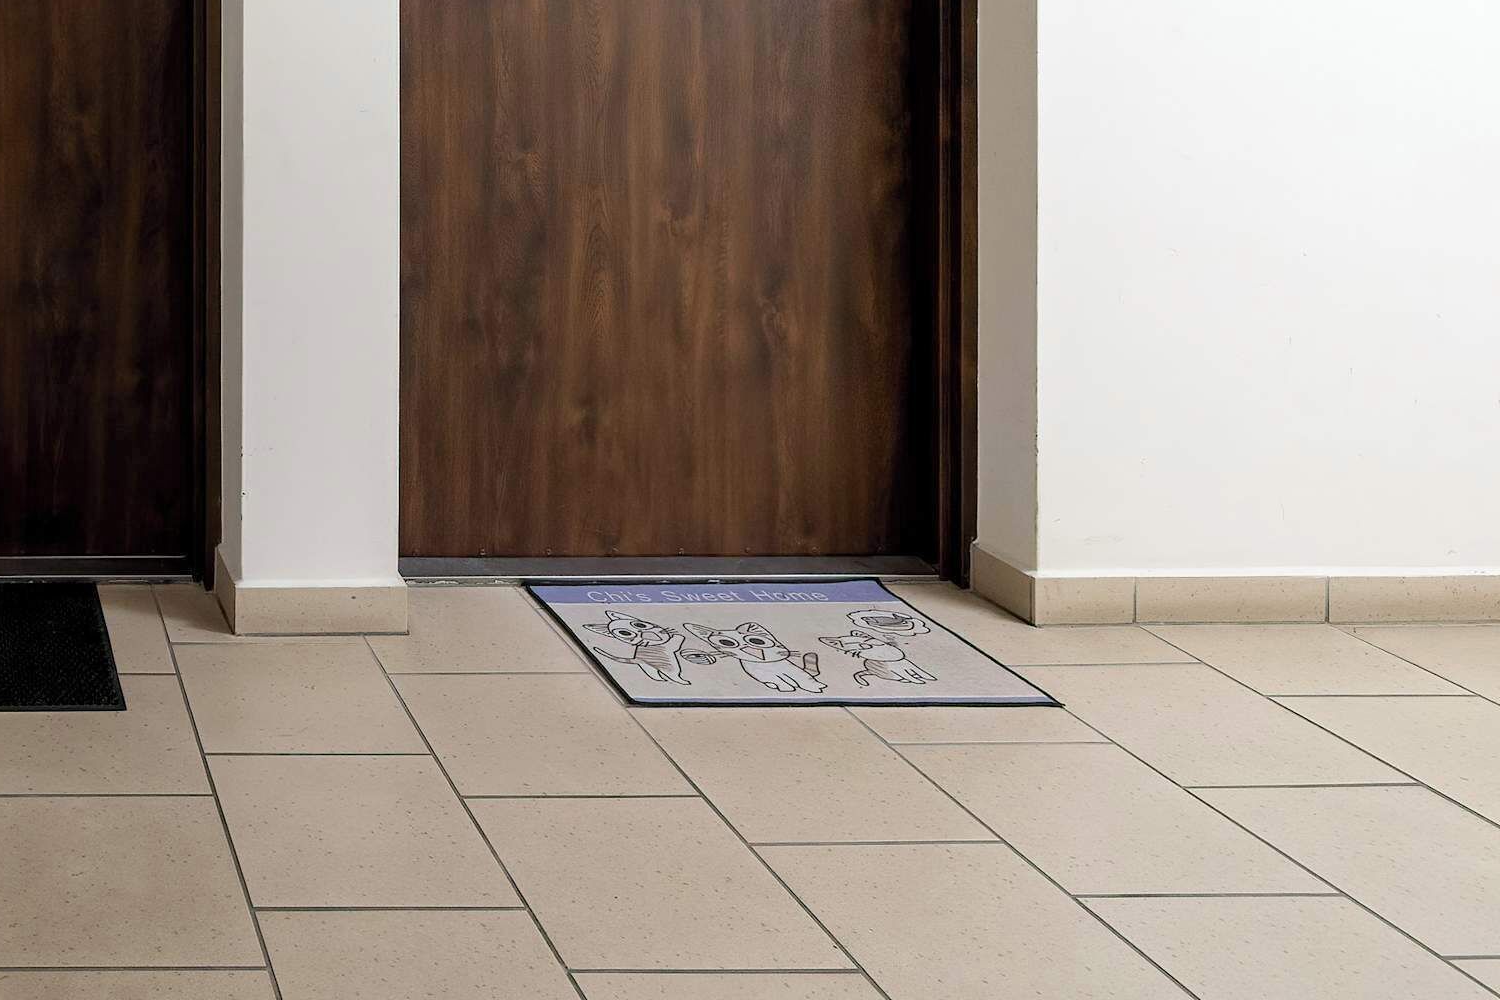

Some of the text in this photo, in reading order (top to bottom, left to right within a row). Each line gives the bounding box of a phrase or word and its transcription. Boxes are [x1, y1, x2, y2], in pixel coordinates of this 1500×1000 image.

[586, 590, 829, 602] Chi's Sweet Home
